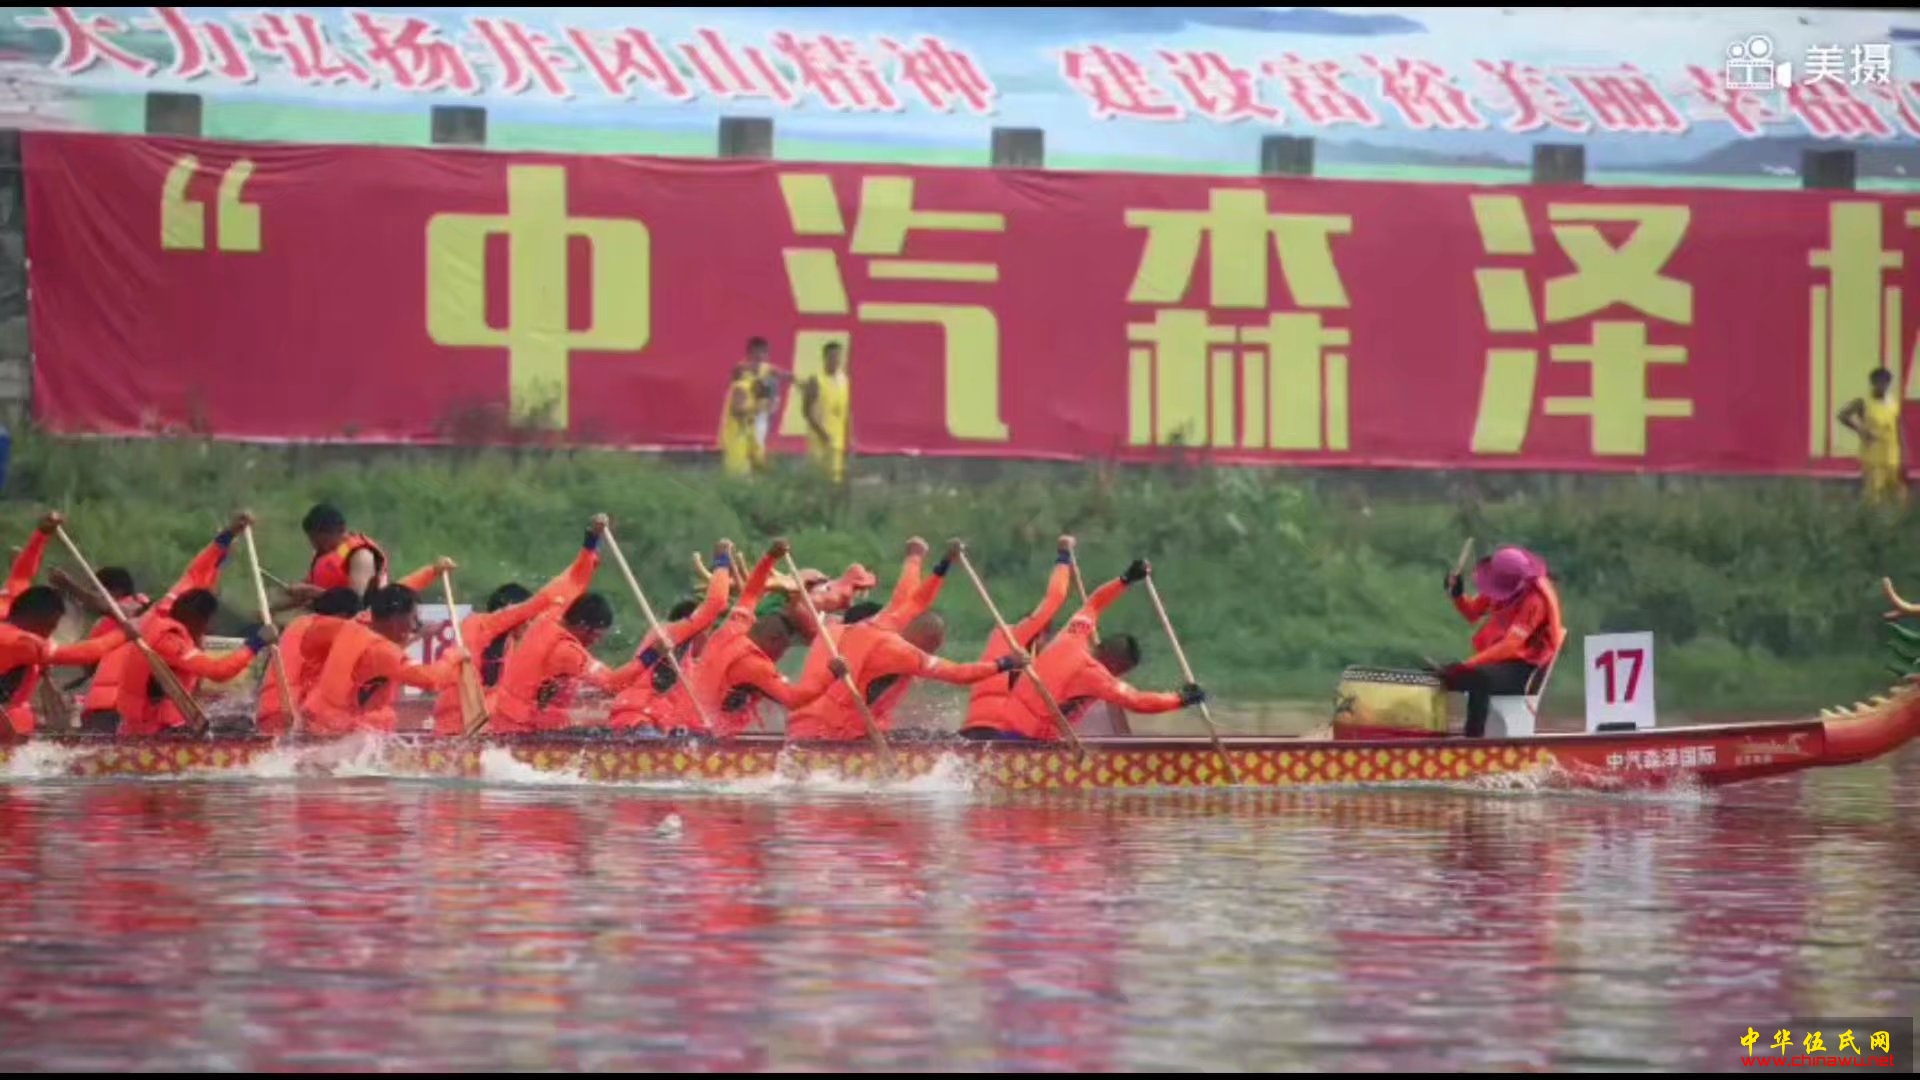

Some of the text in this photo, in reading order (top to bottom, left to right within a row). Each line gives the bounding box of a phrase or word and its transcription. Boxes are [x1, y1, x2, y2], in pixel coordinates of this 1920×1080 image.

[1595, 648, 1644, 705] 17
[1606, 745, 1717, 769] 中汽森泽国际
